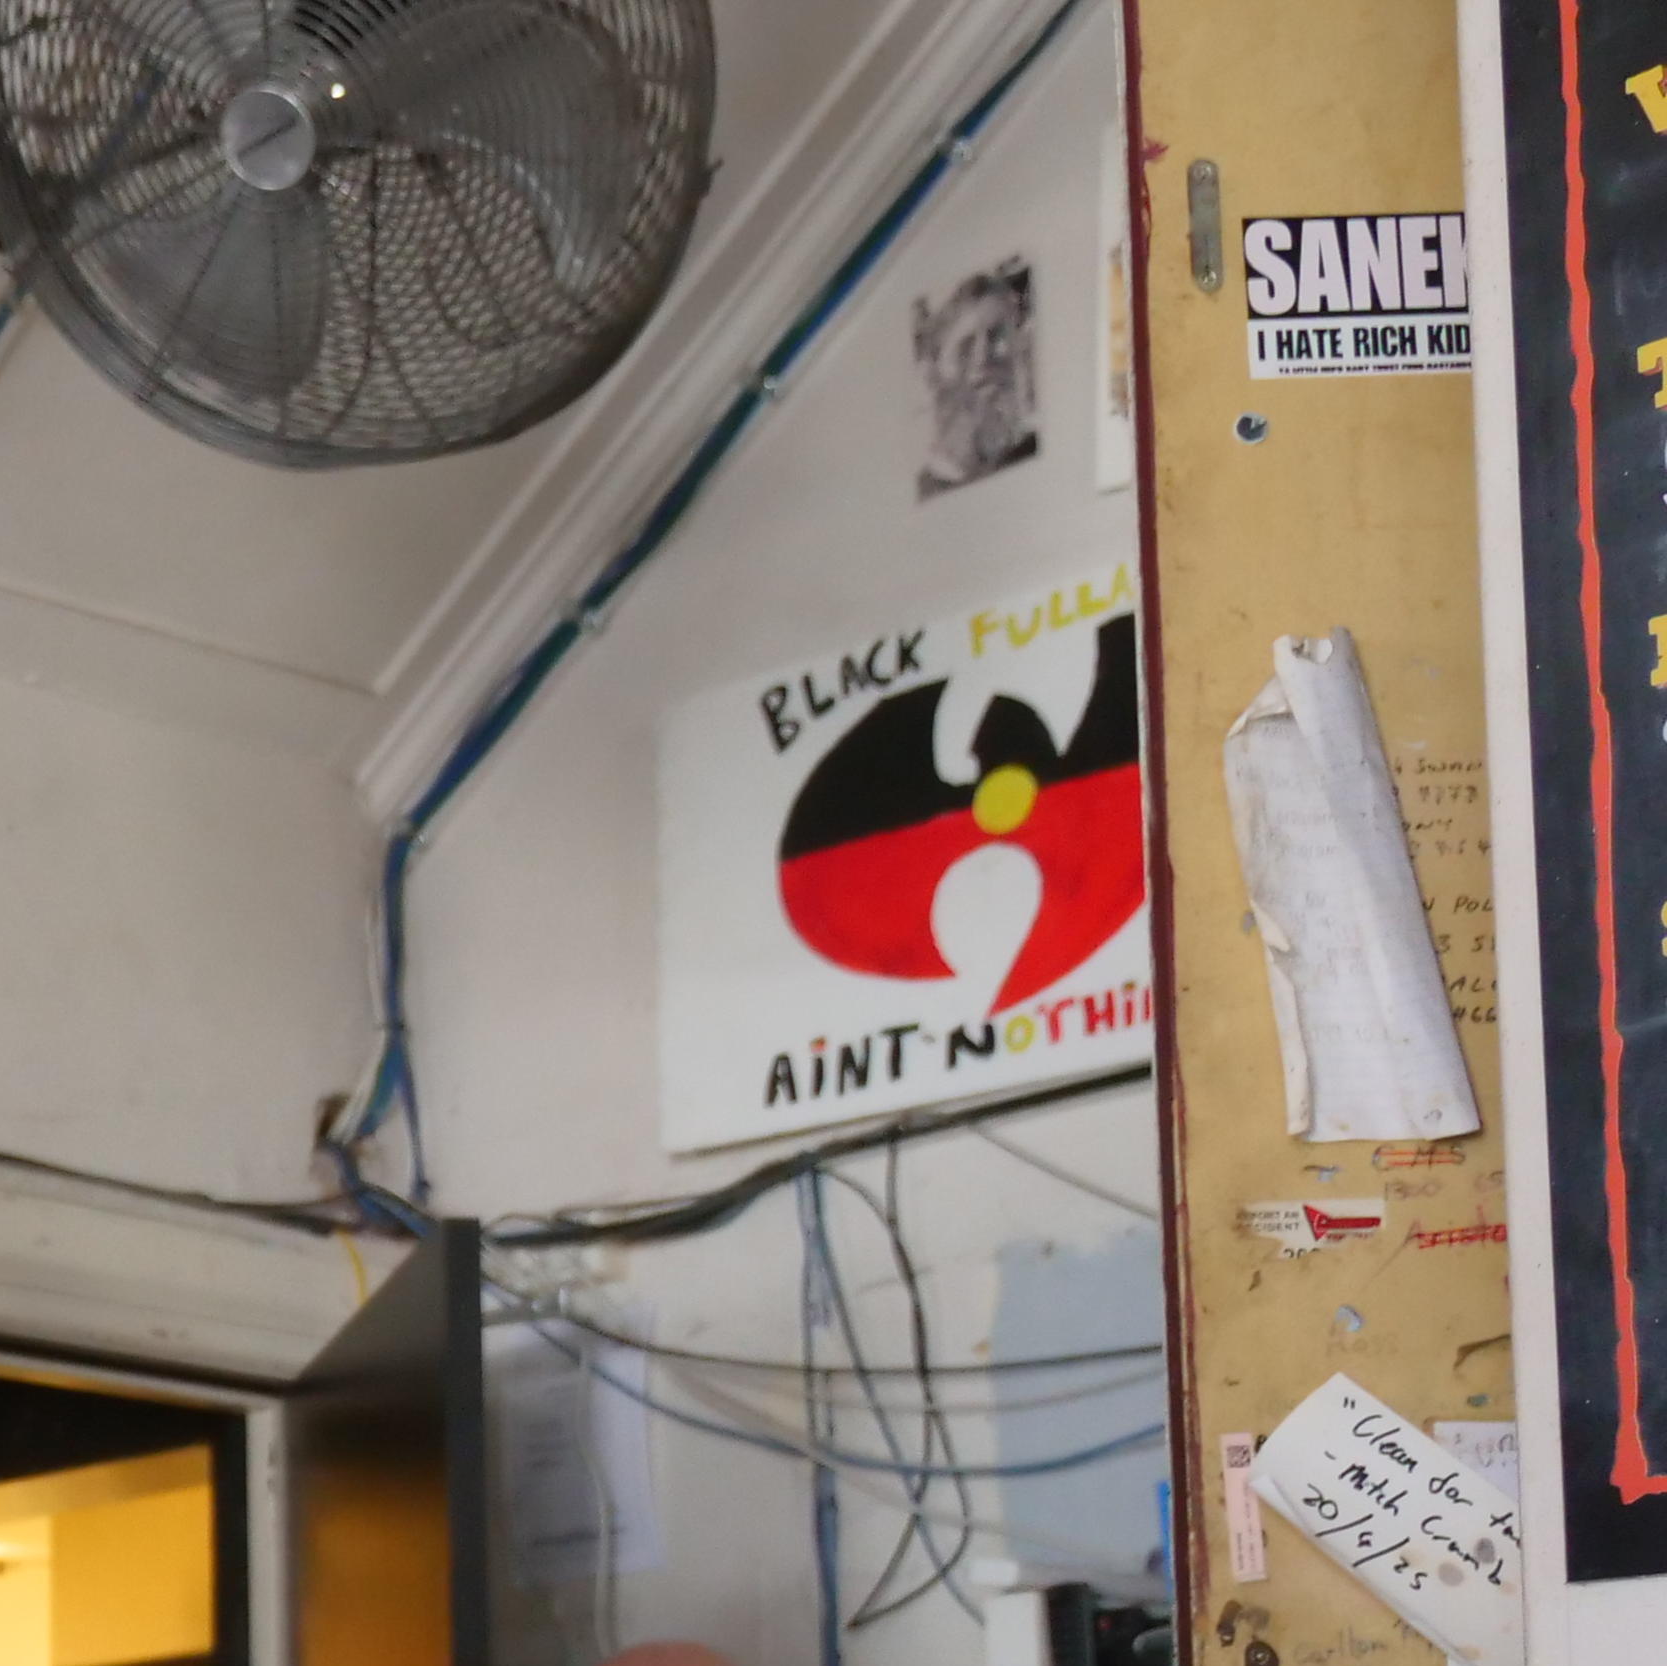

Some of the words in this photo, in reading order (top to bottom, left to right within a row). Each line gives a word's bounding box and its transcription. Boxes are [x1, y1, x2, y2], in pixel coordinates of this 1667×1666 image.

[1257, 330, 1266, 360] I
[1276, 328, 1343, 360] HATE
[1353, 325, 1417, 358] RICH
[758, 628, 928, 753] BLACK
